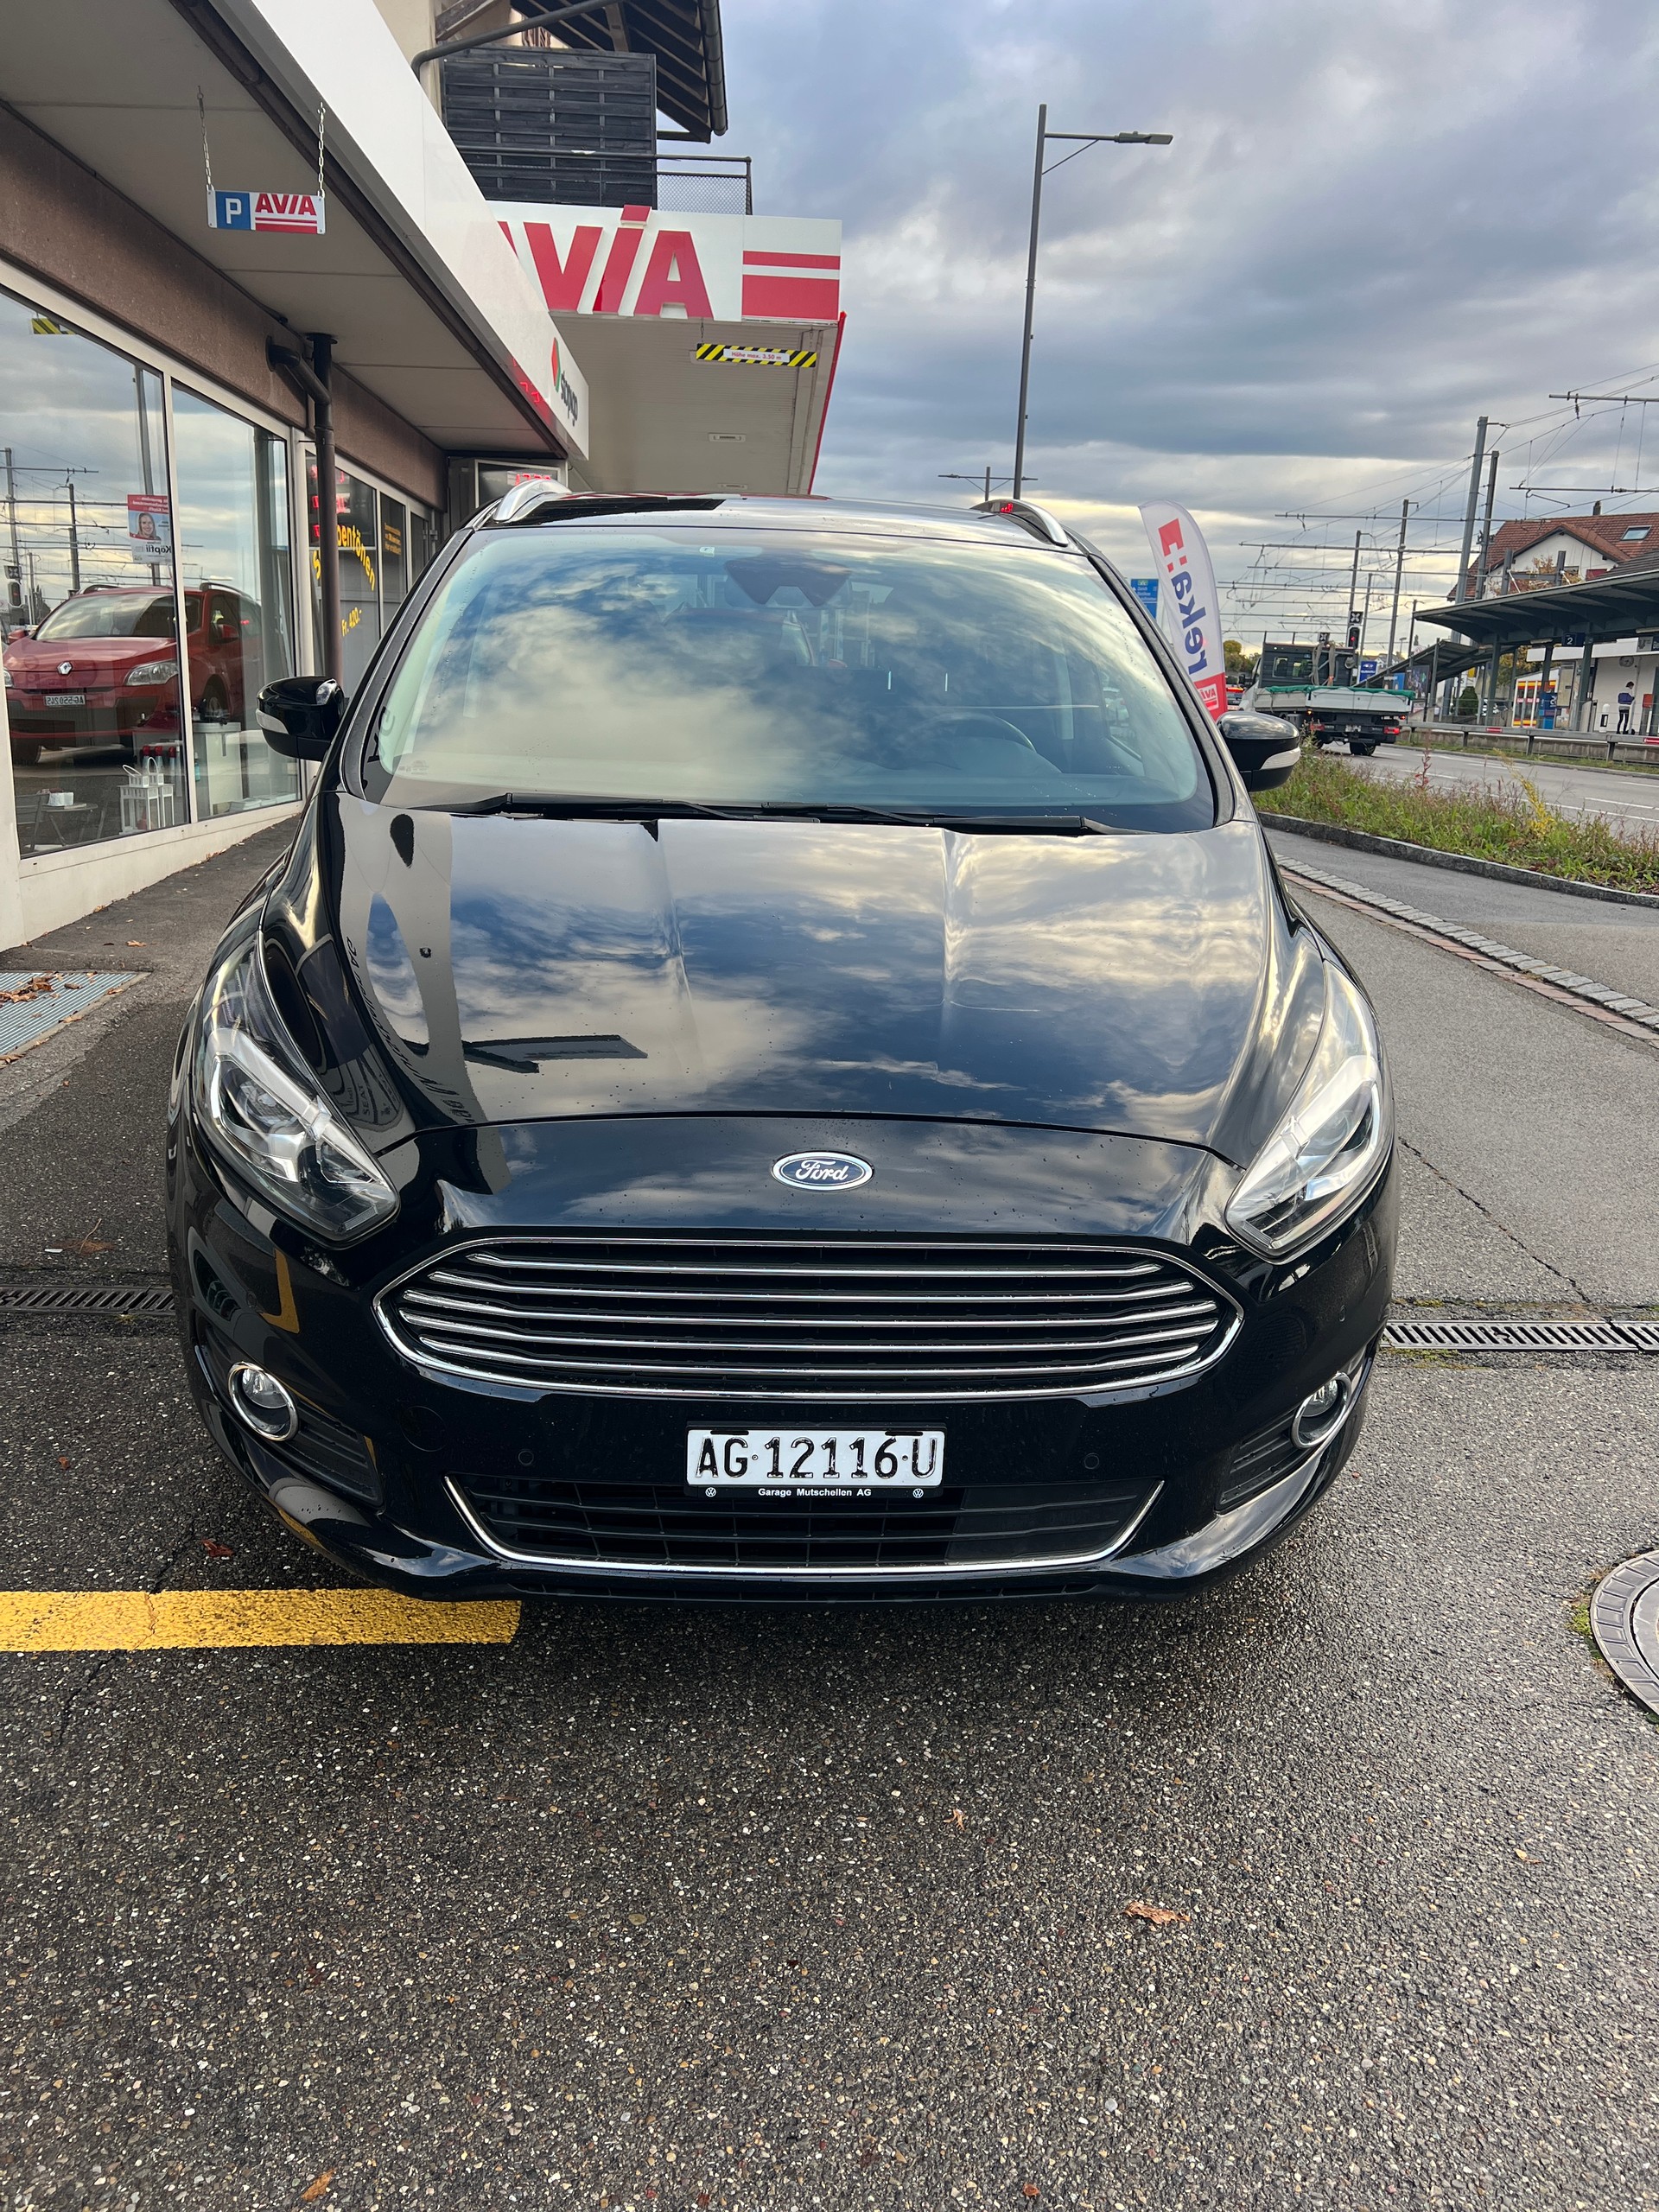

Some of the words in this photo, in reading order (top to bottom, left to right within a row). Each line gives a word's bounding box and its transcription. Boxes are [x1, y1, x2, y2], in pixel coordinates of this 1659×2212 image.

[226, 198, 242, 225] P
[255, 193, 317, 216] AVIA
[498, 205, 714, 318] VIA
[1567, 637, 1573, 645] 2
[795, 1160, 849, 1180] Ford
[758, 1488, 791, 1497] Garage
[797, 1488, 852, 1497] Mutschellen
[857, 1488, 872, 1497] AG
